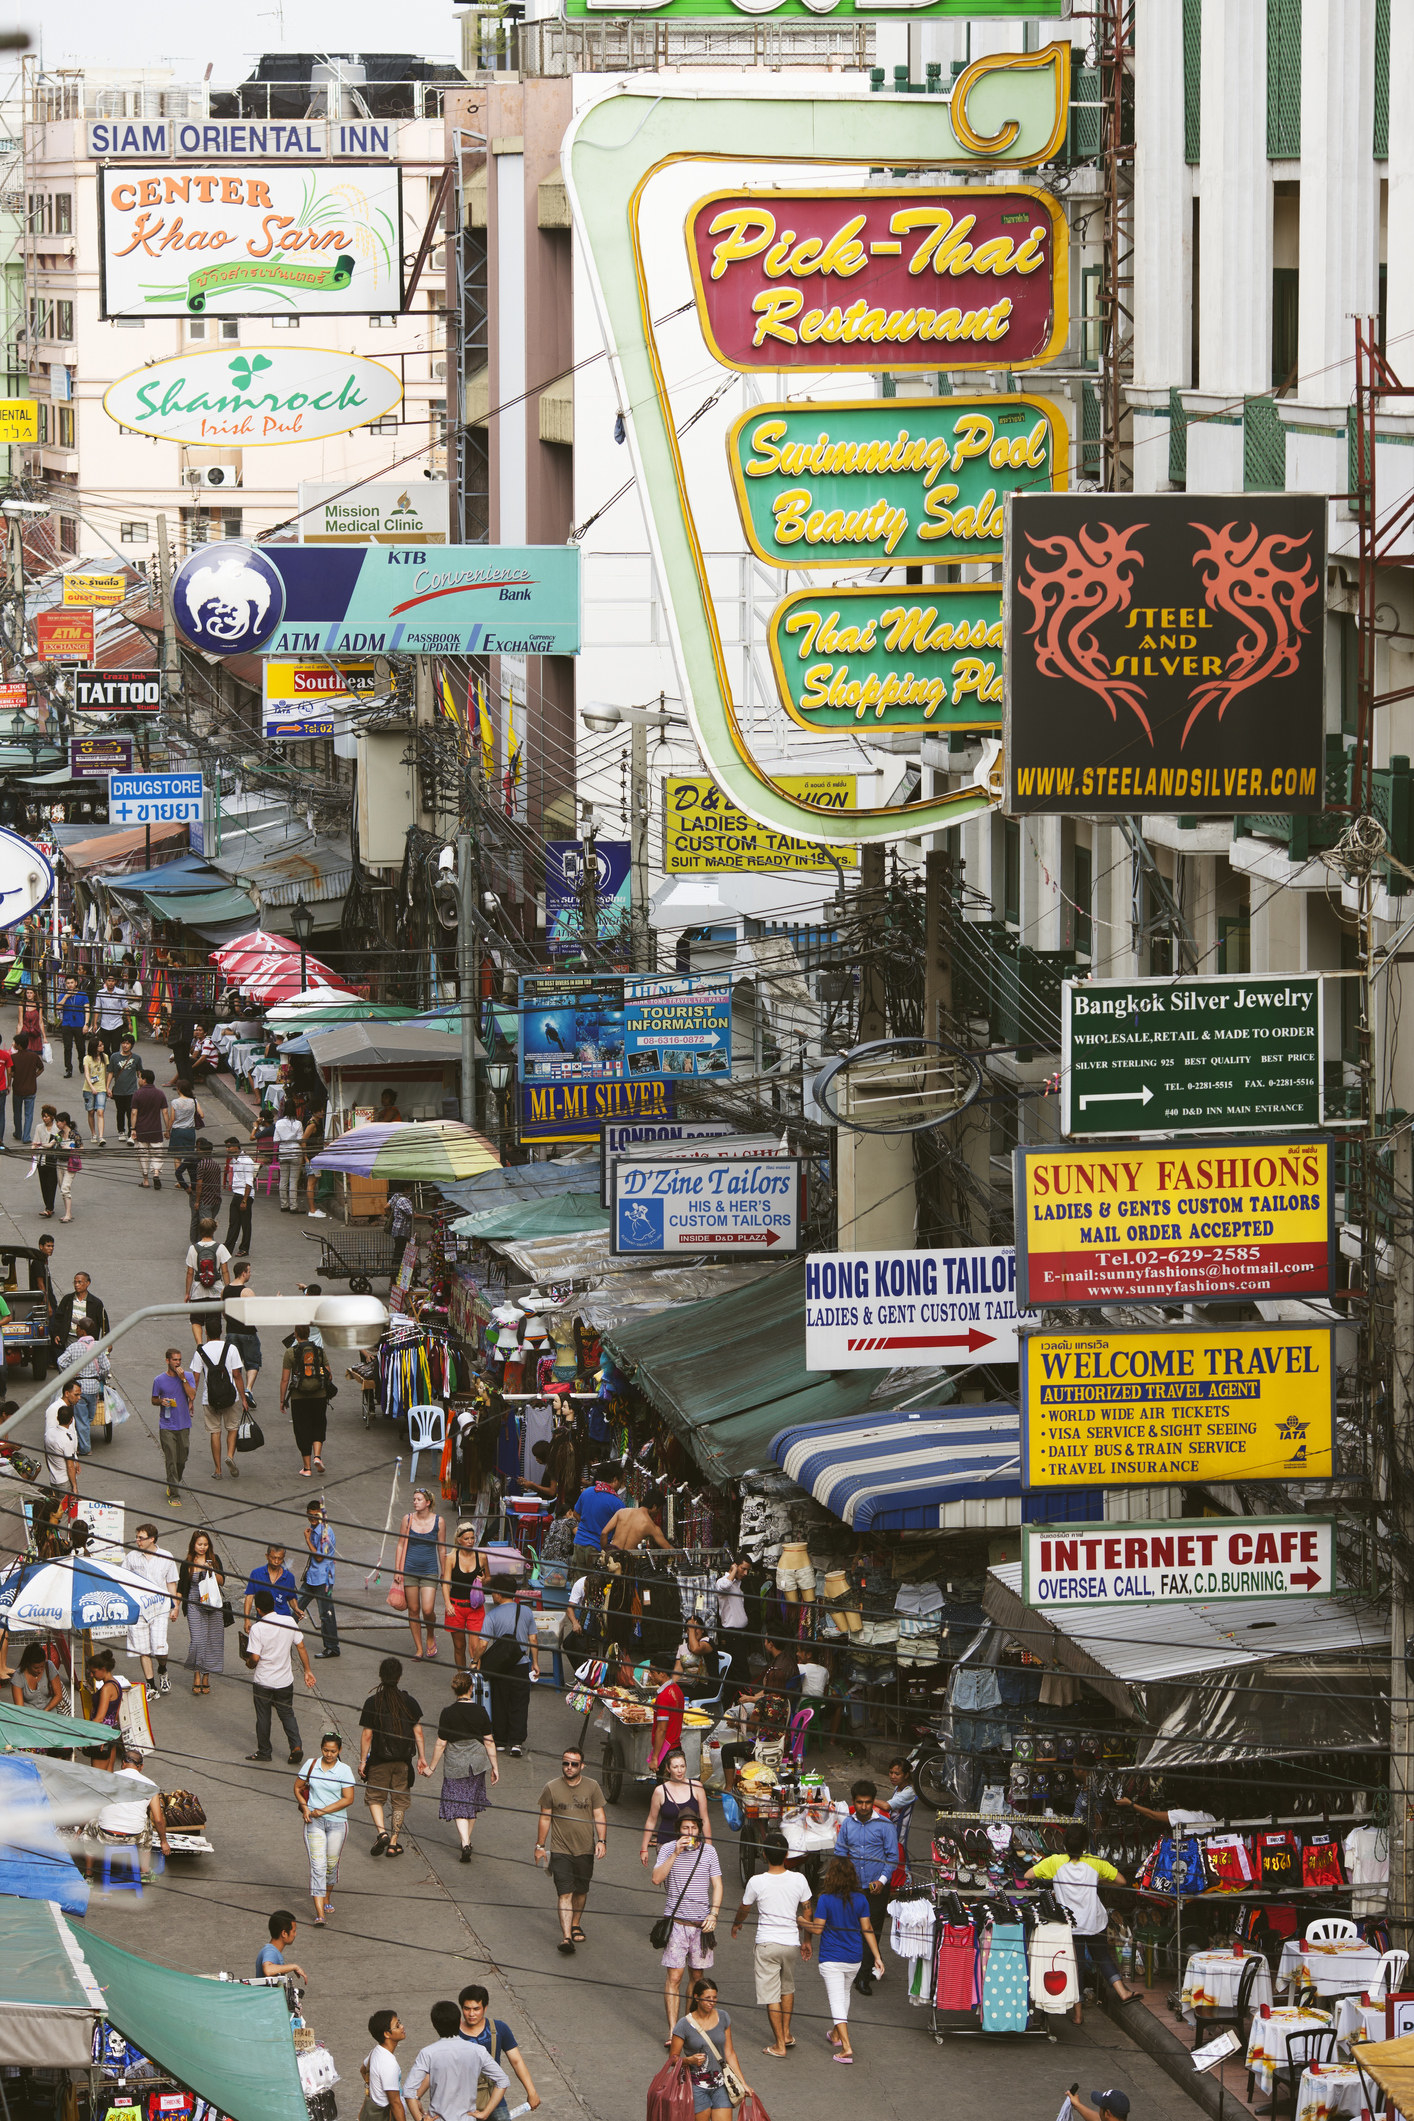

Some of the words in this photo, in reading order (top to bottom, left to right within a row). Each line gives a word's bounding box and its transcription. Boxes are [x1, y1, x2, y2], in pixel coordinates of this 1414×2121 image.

[92, 125, 166, 152] SIAM
[180, 125, 321, 152] ORIENTAL
[340, 126, 388, 152] INN
[111, 176, 274, 210] CENTER
[112, 212, 238, 258] Khao
[246, 214, 353, 258] Sarn
[708, 206, 1046, 280] Pick-Thai
[752, 286, 1014, 347] Restaurant
[135, 374, 368, 421] Shamrock
[201, 414, 255, 437] Irish
[262, 414, 304, 436] Pub
[746, 420, 950, 488] Swimming
[950, 414, 1048, 472] Pool
[325, 505, 380, 518] Mission
[326, 520, 380, 532] Medical
[384, 518, 423, 530] Clinic
[772, 488, 908, 554] Beauty
[388, 551, 426, 564] KTB
[413, 564, 531, 594] Convenience
[499, 588, 532, 600] Bank
[1125, 608, 1213, 628] STEEL
[51, 628, 82, 638] ATM
[276, 633, 320, 651] ATM
[338, 633, 385, 651] ADM
[406, 633, 461, 643] PASSBOOK
[786, 611, 877, 659] Thai
[1138, 634, 1197, 650] AND
[422, 643, 461, 652] UPDATE
[1110, 656, 1223, 676] SILVER
[103, 673, 128, 681] Crazy
[78, 682, 159, 703] TATTOO
[800, 663, 947, 718] Shopping
[113, 780, 200, 796] DRUGSTORE
[1017, 767, 1316, 796] WWW.STEELANDSILVER.COM
[137, 803, 199, 821] ขายยา
[681, 816, 747, 831] LADIES
[675, 836, 757, 851] CUSTOM
[671, 856, 700, 867] SUIT
[705, 856, 743, 867] MADE
[747, 856, 791, 866] READY
[795, 855, 807, 865] IN
[811, 853, 825, 864] 18
[640, 1006, 715, 1018] TOURIST
[1074, 993, 1165, 1018] Bangkok
[1170, 992, 1229, 1011] Silver
[1234, 988, 1313, 1012] Jewelry
[626, 1018, 728, 1031] INFORMATION
[643, 1036, 705, 1045] 08-6316-0872
[1074, 1030, 1199, 1044] WHOLESALE,RETAIL
[1201, 1030, 1211, 1040] &
[1214, 1029, 1250, 1040] MADE
[1252, 1028, 1269, 1038] TO
[1272, 1027, 1314, 1037] ORDER
[1076, 1062, 1108, 1070] SILVER
[1112, 1059, 1157, 1068] STERLING
[1184, 1057, 1207, 1066] BEST
[1211, 1056, 1252, 1066] QUALITY
[1261, 1055, 1283, 1063] BEST
[1164, 1082, 1184, 1091] TEL.
[1187, 1081, 1233, 1090] 0-2281-5515
[1245, 1080, 1265, 1088] FAX.
[1268, 1078, 1314, 1087] 0-2281-5516
[530, 1085, 588, 1121] MI-MI
[595, 1081, 668, 1118] SILVER
[1164, 1108, 1178, 1116] #40
[1183, 1107, 1203, 1115] D&D
[1227, 1106, 1251, 1114] MAIN
[1255, 1104, 1304, 1113] ENTRANCE
[624, 1169, 703, 1195] D'Zine
[708, 1166, 791, 1194] Tailors
[1033, 1162, 1143, 1196] SUNNY
[1156, 1156, 1319, 1191] FASHIONS
[689, 1201, 711, 1212] HIS
[715, 1201, 725, 1212] &
[730, 1200, 771, 1212] HER'S
[1034, 1203, 1092, 1221] LADIES
[1099, 1203, 1110, 1218] &
[1118, 1200, 1170, 1216] GENTS
[1177, 1198, 1243, 1215] CUSTOM
[1250, 1194, 1320, 1211] TAILORS
[669, 1215, 728, 1226] CUSTOM
[736, 1214, 791, 1226] TAILORS
[1080, 1226, 1120, 1243] MAIL
[1127, 1223, 1181, 1240] ORDER
[1189, 1220, 1274, 1239] ACCEPTED
[1096, 1247, 1261, 1266] Tel.02-629-2585
[806, 1260, 868, 1300] HONG
[876, 1258, 937, 1296] KONG
[1043, 1261, 1314, 1283] E-mail:sunnyfashions@hotmail.com
[1088, 1279, 1270, 1296] www.sunnyfashions.com
[807, 1307, 858, 1326] LADIES
[863, 1306, 873, 1325] &
[878, 1304, 916, 1324] GENT
[920, 1302, 981, 1322] CUSTOM
[1041, 1349, 1194, 1379] WELCOME
[1204, 1346, 1319, 1375] TRAVEL
[1043, 1384, 1142, 1402] AUTHORIZED
[1145, 1383, 1204, 1399] TRAVEL
[1208, 1382, 1258, 1398] AGENT
[1049, 1410, 1095, 1422] WORLD
[1101, 1408, 1134, 1420] WIDE
[1140, 1407, 1165, 1419] AIR
[1172, 1405, 1229, 1418] TICKETS
[1049, 1428, 1081, 1440] VISA
[1087, 1426, 1146, 1439] SERVICE
[1149, 1425, 1158, 1437] &
[1160, 1424, 1202, 1437] SIGHT
[1207, 1423, 1257, 1435] SEEING
[1280, 1431, 1306, 1440] IATA
[1049, 1445, 1088, 1457] DAILY
[1094, 1444, 1122, 1456] BUS
[1125, 1444, 1134, 1456] &
[1137, 1442, 1182, 1455] TRAIN
[1188, 1441, 1246, 1453] SERVICE
[1049, 1463, 1105, 1476] TRAVEL
[1111, 1461, 1198, 1474] INSURANCE
[1041, 1535, 1218, 1572] INTERNET
[1228, 1531, 1318, 1565] CAFE
[1038, 1577, 1107, 1600] OVERSEA
[1114, 1575, 1155, 1597] CALL,
[1161, 1573, 1192, 1595] FAX,
[1194, 1571, 1288, 1594] C.D.BURNING,
[17, 1604, 62, 1620] Chang
